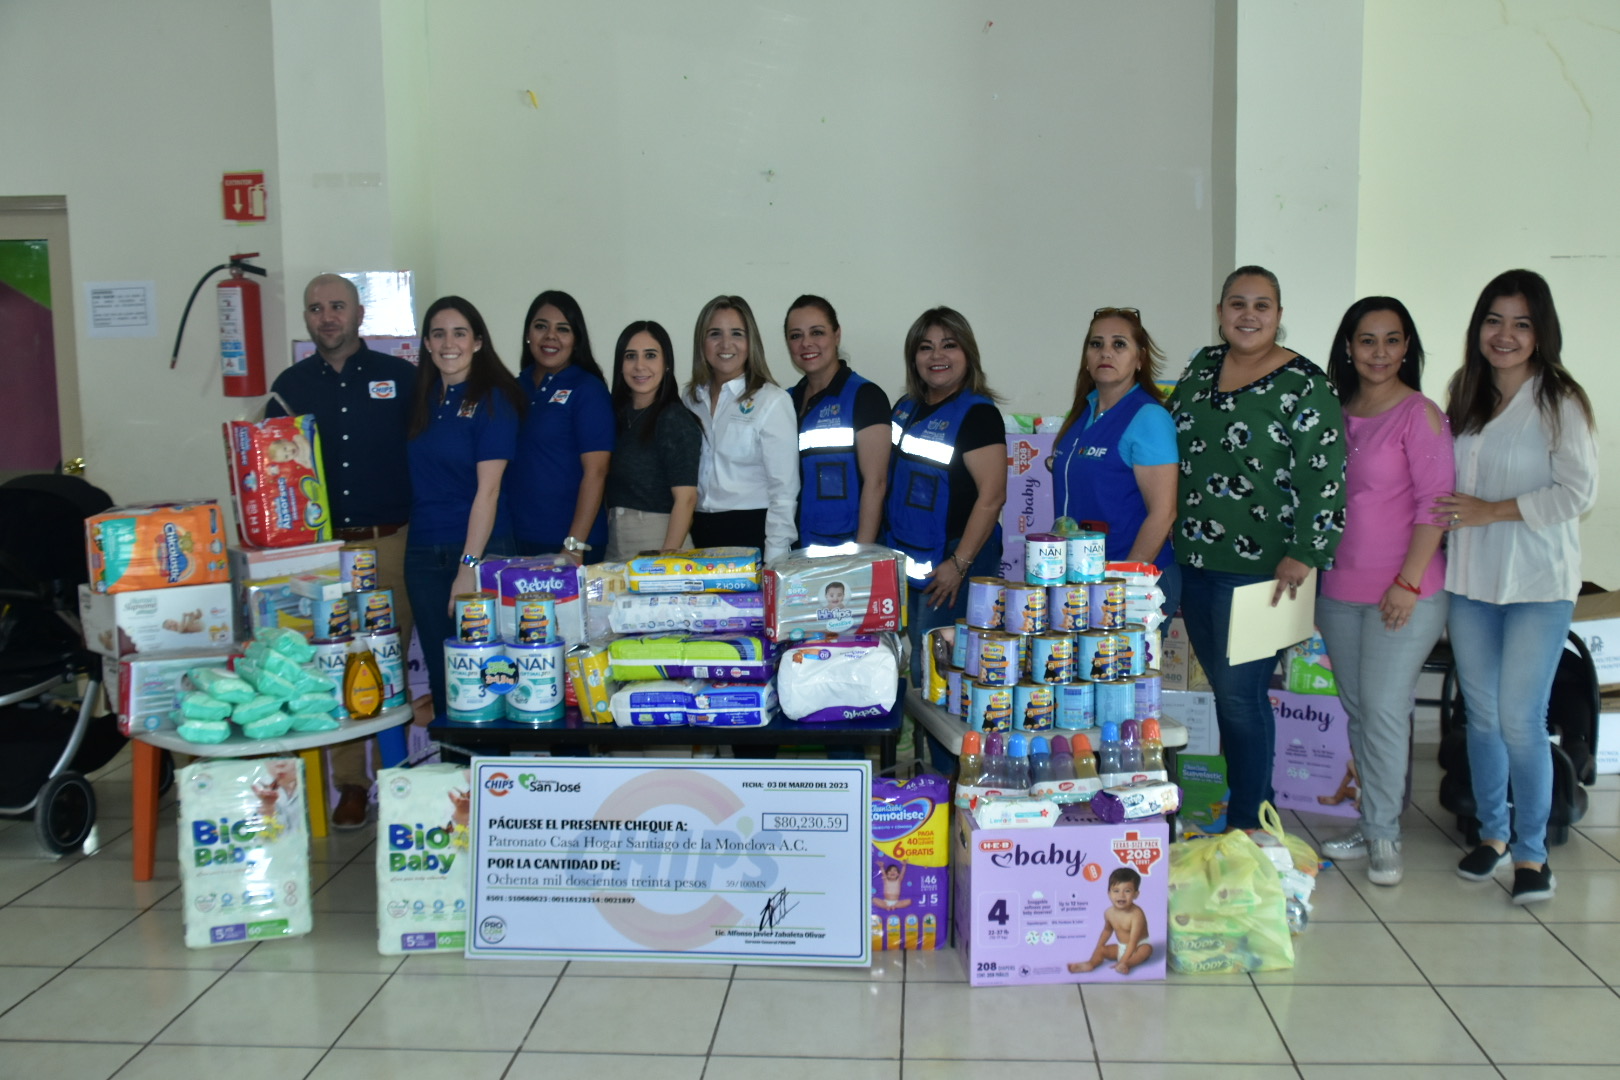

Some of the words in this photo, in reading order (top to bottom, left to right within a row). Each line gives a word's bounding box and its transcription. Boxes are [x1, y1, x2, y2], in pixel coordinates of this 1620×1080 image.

[1086, 446, 1108, 457] DIF
[1021, 476, 1041, 515] baby
[1039, 548, 1062, 557] NAN
[1083, 545, 1104, 553] NAN
[514, 577, 565, 595] Bebyto
[882, 598, 894, 615] 3
[448, 656, 483, 671] NAN
[516, 657, 556, 671] NAN
[478, 685, 487, 697] 3
[550, 684, 558, 697] 3
[844, 707, 882, 719] Bebyto
[1280, 702, 1335, 732] baby
[485, 780, 514, 790] CHIPS
[530, 781, 551, 792] San
[554, 781, 581, 793] José
[774, 816, 842, 830] $80,230.59
[871, 811, 924, 822] omodisec
[489, 816, 543, 830] PÁGUESE
[546, 819, 558, 830] EL
[561, 820, 621, 831] PRESENTE
[624, 820, 673, 833] CHEQUE
[676, 821, 688, 832] A:
[389, 823, 451, 851] Bio
[489, 836, 546, 847] Patronato
[550, 836, 580, 848] Casa
[584, 836, 622, 851] Hogar
[626, 837, 680, 852] Santiago
[683, 838, 697, 849] de
[701, 838, 712, 849] la
[716, 839, 776, 850] Monclova
[779, 840, 808, 851] A.C.
[893, 841, 905, 859] 6
[905, 848, 934, 857] GRATIS
[1015, 843, 1087, 877] baby
[1126, 849, 1151, 860] 208
[389, 851, 456, 875] Baby
[487, 858, 514, 870] POR
[516, 858, 531, 870] LA
[534, 859, 598, 871] CANTIDAD
[601, 860, 620, 871] DE:
[487, 873, 540, 885] Ochenta
[543, 874, 562, 886] mil
[565, 874, 628, 887] doscientos
[631, 876, 671, 888] treinta
[675, 879, 707, 891] pesos
[925, 875, 937, 885] 46
[918, 894, 926, 905] J
[930, 893, 938, 904] 5
[987, 899, 1010, 926] 4
[484, 921, 503, 929] PRO
[215, 927, 225, 941] 5
[406, 935, 416, 947] 5
[977, 962, 997, 971] 208
